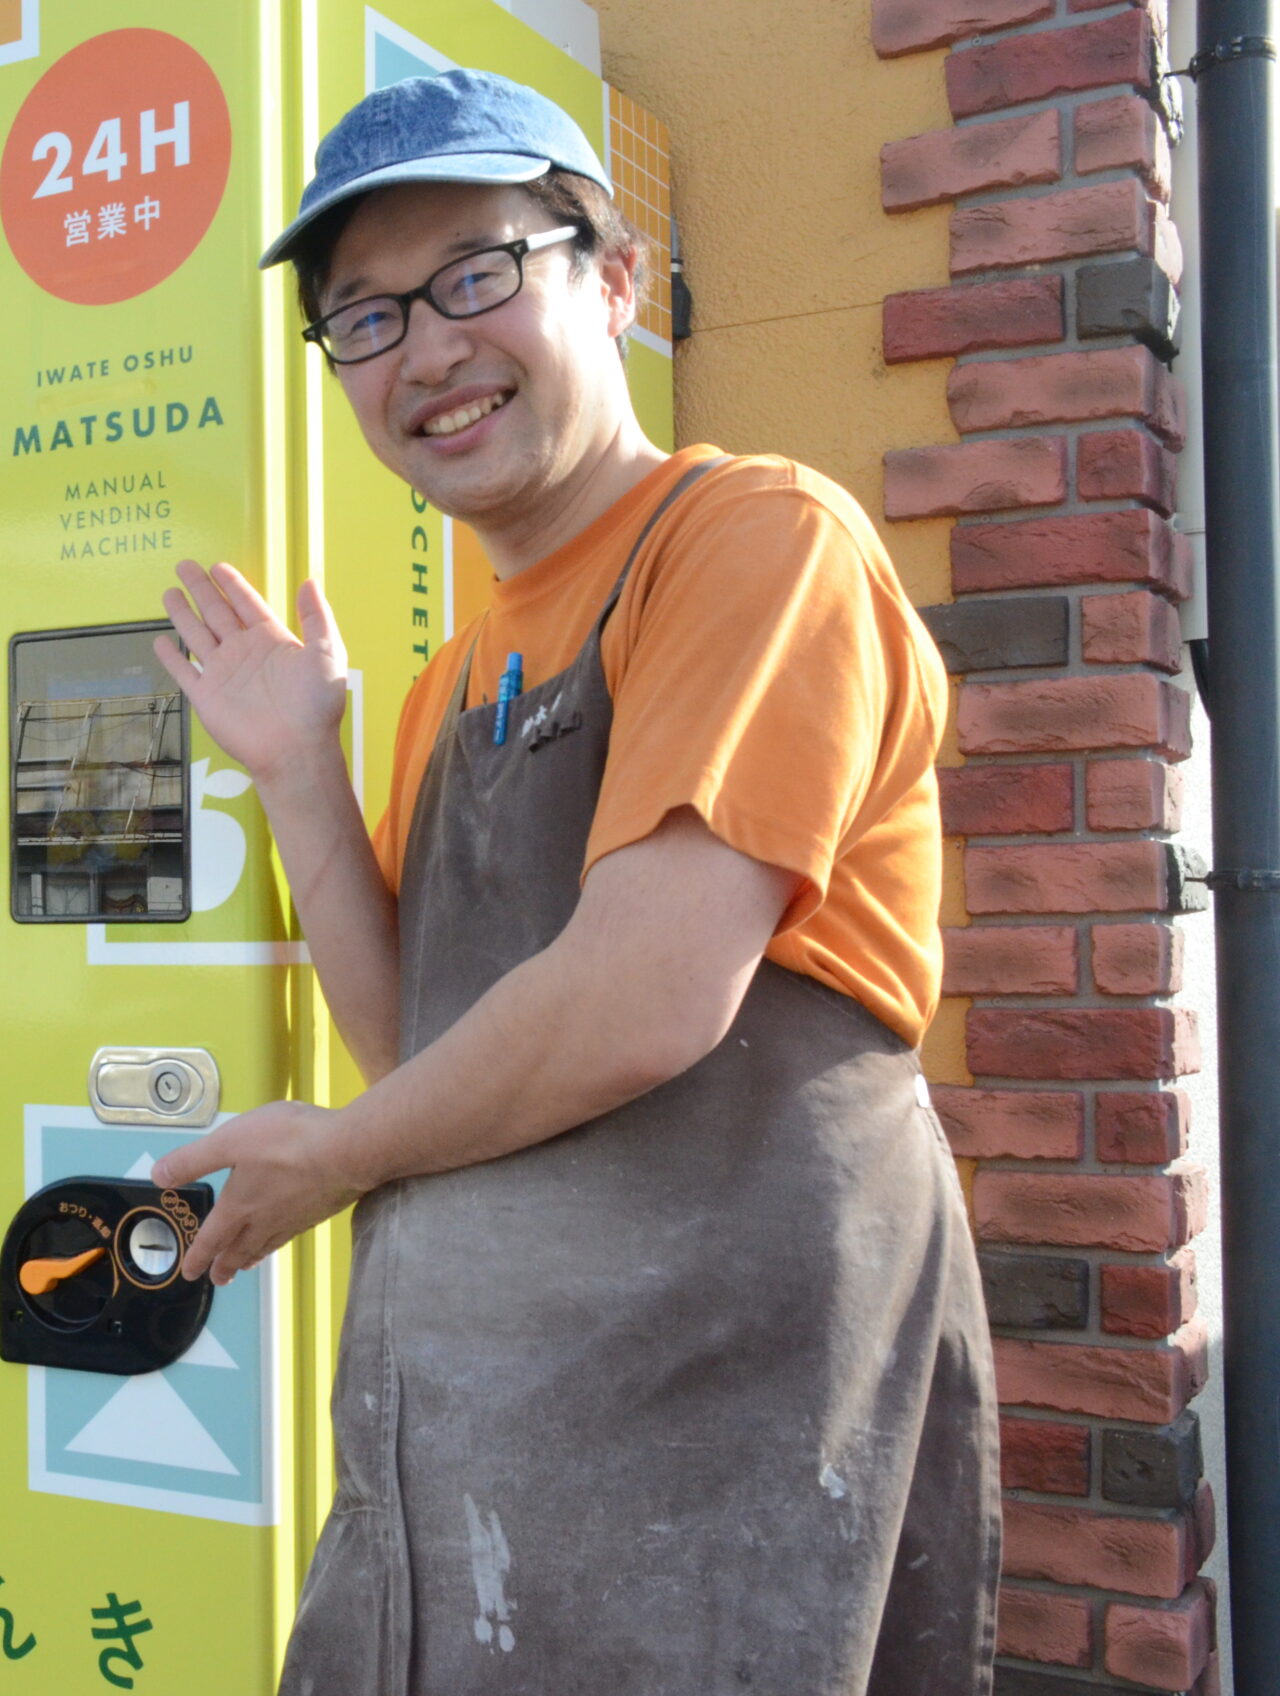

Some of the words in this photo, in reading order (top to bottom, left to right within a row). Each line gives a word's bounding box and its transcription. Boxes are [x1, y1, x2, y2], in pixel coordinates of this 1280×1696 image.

[32, 100, 190, 200] 24H
[64, 195, 160, 247] 営業中
[37, 359, 109, 387] IWATE
[124, 345, 193, 372] OSHU
[13, 396, 224, 456] MATSUDA
[65, 471, 167, 501] MANUAL
[59, 500, 171, 531] VENDING
[60, 530, 172, 560] MACHINE
[411, 486, 428, 677] OCHET
